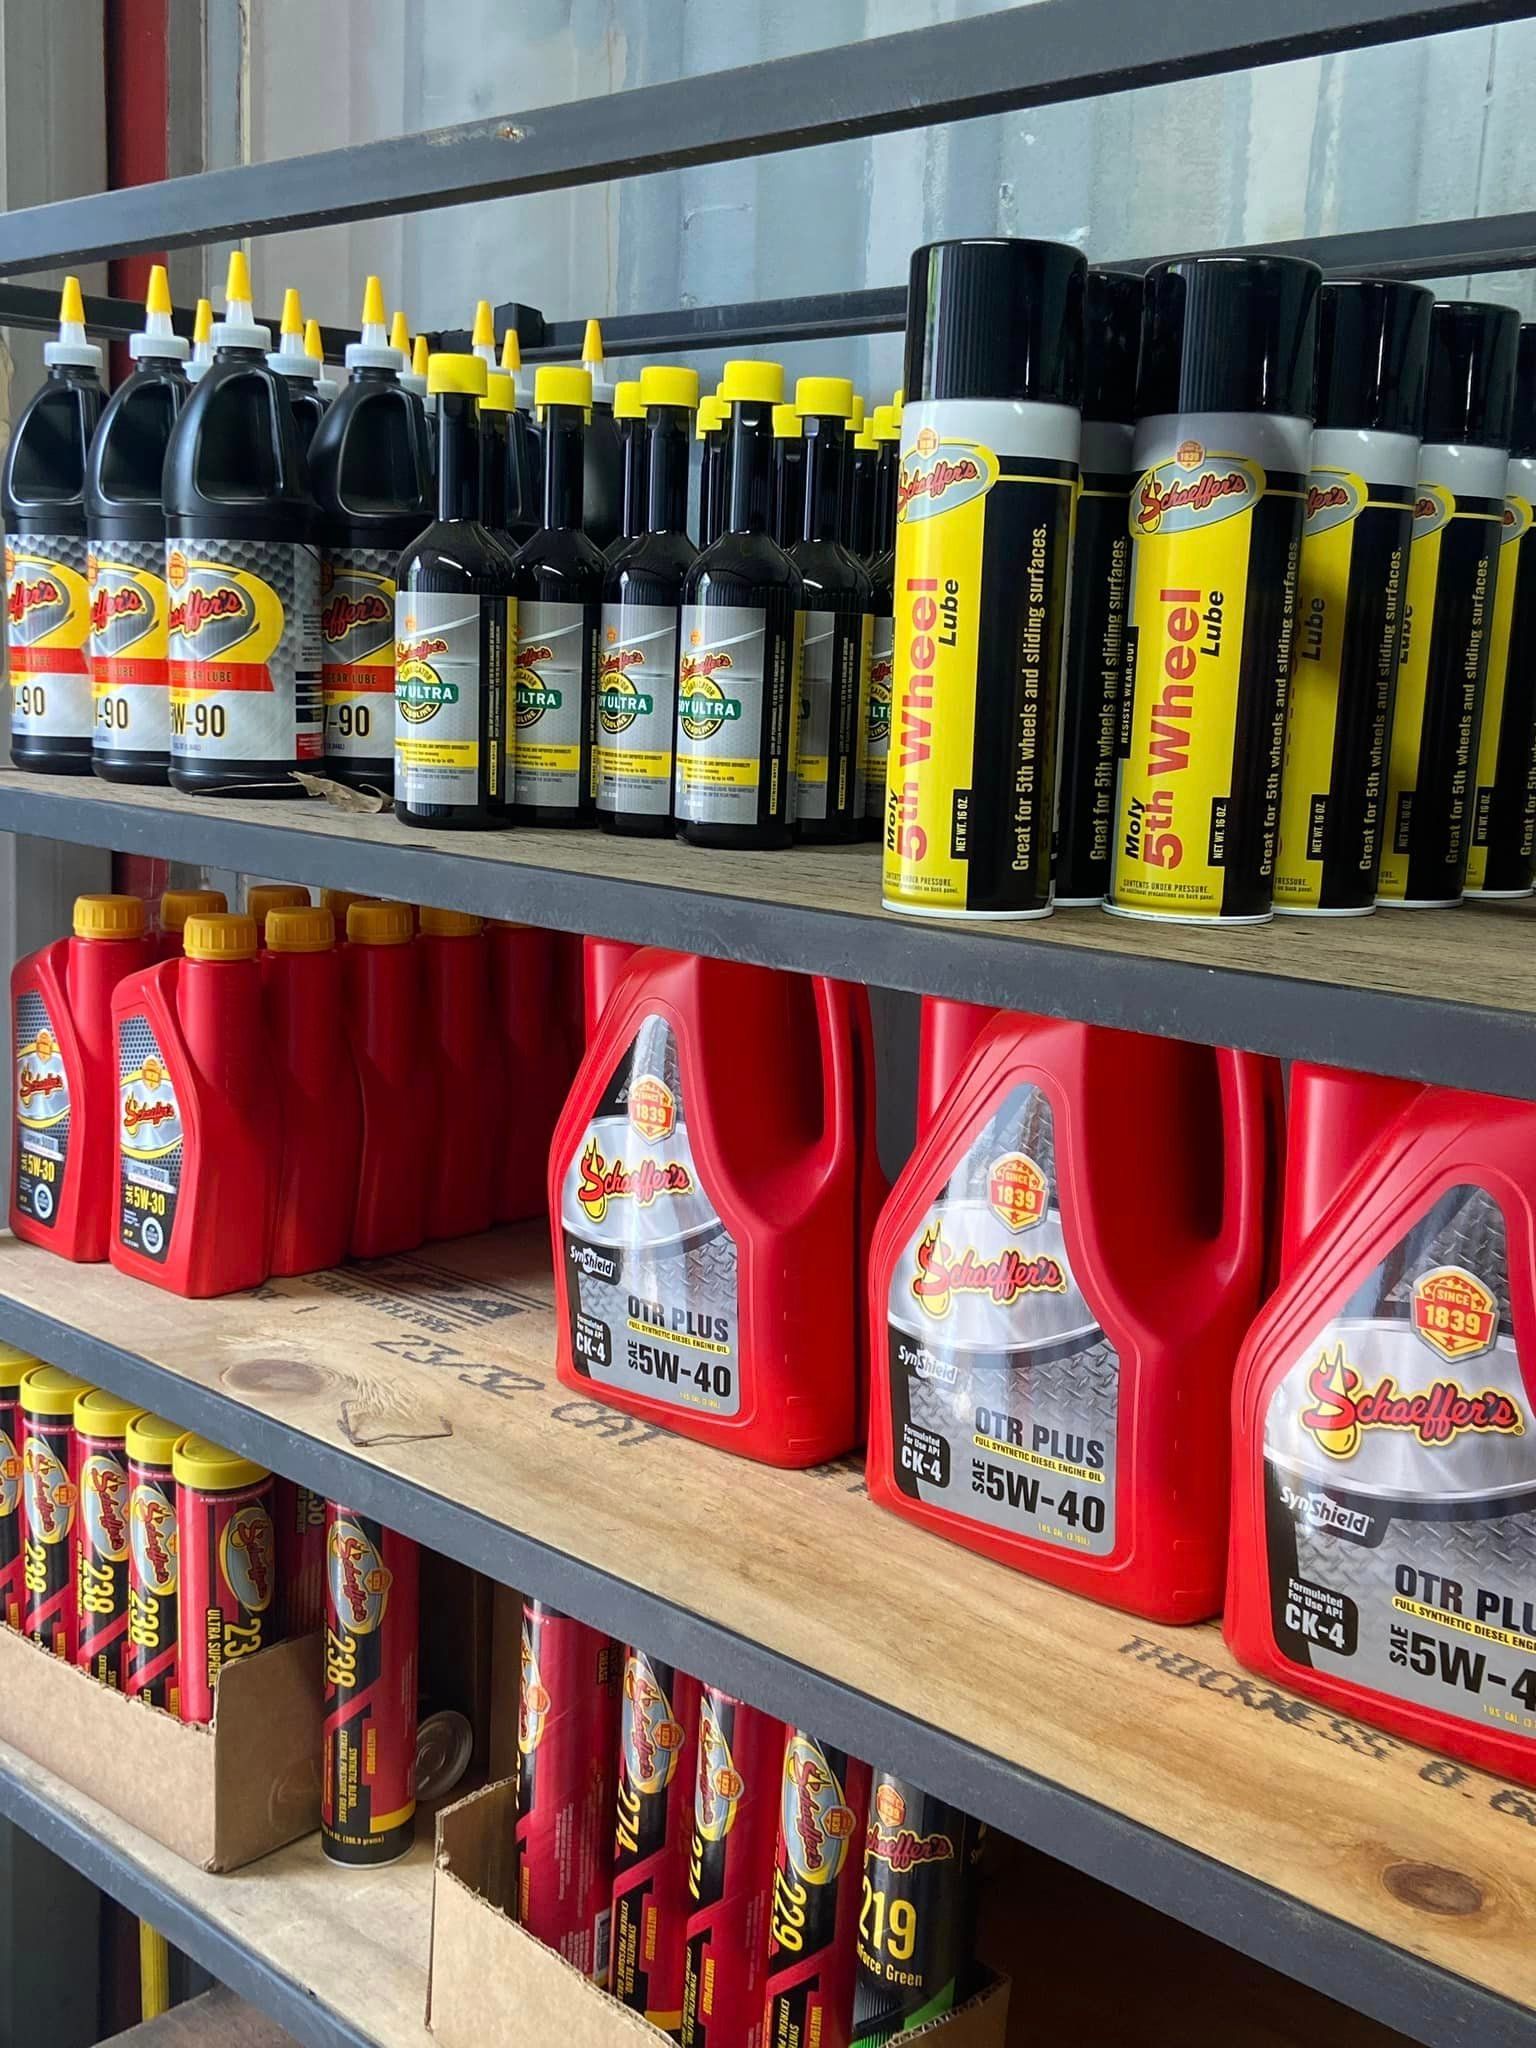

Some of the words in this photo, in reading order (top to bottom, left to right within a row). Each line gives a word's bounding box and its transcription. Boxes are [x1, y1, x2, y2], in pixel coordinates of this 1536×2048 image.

[1138, 474, 1247, 524] Schaeffer's
[1027, 523, 1047, 603] surfaces.
[1107, 536, 1126, 609] surfaces.
[1386, 547, 1402, 620] surfaces.
[1472, 554, 1489, 625] surfaces.
[938, 579, 959, 647] Lube
[1023, 599, 1045, 663] sliding
[1201, 591, 1224, 656] Lube
[1303, 598, 1326, 661] Lube
[1103, 612, 1122, 665] sliding
[1278, 616, 1293, 672] sliding
[1380, 621, 1394, 676] sliding
[1464, 627, 1482, 678] sliding
[207, 670, 232, 684] LUBE
[352, 674, 377, 686] LUBE
[899, 578, 938, 767] Wheel
[1022, 668, 1039, 698] and
[1102, 668, 1119, 699] and
[1124, 642, 1134, 697] WEAR-OUT
[1148, 589, 1201, 776] Wheel
[12, 685, 46, 716] -90
[95, 698, 129, 729] -90
[408, 685, 453, 701] ULTRA
[607, 695, 648, 711] ULTRA
[691, 702, 735, 717] ULTRA
[1276, 678, 1289, 707] and
[1374, 682, 1389, 710] and
[1461, 683, 1477, 710] and
[1020, 703, 1037, 760] wheels
[1097, 704, 1116, 758] wheels
[1120, 701, 1132, 743] RESISTS
[1271, 713, 1285, 768] wheels
[1370, 714, 1386, 767] wheels
[1456, 715, 1472, 765] wheels
[1016, 764, 1034, 792] 5th
[1095, 764, 1112, 788] 5th
[1266, 772, 1279, 799] 5th
[1366, 772, 1380, 797] 5th
[1452, 769, 1467, 794] 5th
[887, 791, 899, 851] Moly
[896, 782, 928, 862] 5th
[957, 811, 968, 820] 16
[1015, 799, 1032, 825] for
[1093, 792, 1109, 817] for
[1216, 818, 1226, 828] 16
[1264, 805, 1277, 828] for
[1313, 814, 1325, 824] 16
[1364, 801, 1377, 824] for
[1448, 798, 1464, 820] for
[955, 837, 966, 852] NET
[956, 822, 967, 835] WT.
[1012, 829, 1029, 870] Great
[1090, 821, 1107, 860] Great
[1125, 797, 1146, 860] Moly
[1143, 791, 1184, 870] 5th
[1214, 829, 1225, 842] WT.
[1311, 838, 1322, 853] NET
[1359, 829, 1375, 870] Great
[1445, 824, 1461, 863] Great
[1213, 844, 1224, 859] NET
[1259, 832, 1274, 876] Great
[636, 1103, 666, 1123] 1839
[28, 1154, 55, 1182] 5W-30
[578, 1151, 690, 1203] Schaeffer's
[125, 1184, 134, 1204] SAE
[134, 1186, 166, 1216] 5W-30
[997, 1186, 1036, 1210] 1839
[569, 1245, 614, 1276] SynShield
[913, 1240, 1062, 1301] Schaeffer's
[628, 1295, 664, 1327] OTR
[672, 1307, 729, 1342] PLUS
[1436, 1289, 1470, 1306] SINCE
[628, 1321, 640, 1331] FULL
[641, 1325, 671, 1340] SYNTHETIC
[672, 1333, 692, 1346] DIESEL
[693, 1339, 715, 1352] ENGINE
[716, 1345, 728, 1354] OIL
[1425, 1306, 1481, 1335] 1839
[576, 1335, 606, 1362] CK-4
[628, 1339, 639, 1370] SAE
[639, 1344, 732, 1398] 5W-40
[898, 1345, 957, 1384] SynShield
[1303, 1364, 1517, 1442] Schaeffer's
[903, 1424, 940, 1447] Formulated
[903, 1434, 913, 1446] For
[928, 1443, 940, 1457] API
[975, 1406, 1023, 1447] OTR
[1032, 1423, 1105, 1469] PLUS
[901, 1445, 942, 1482] CK-4
[975, 1436, 991, 1449] FULL
[992, 1442, 1030, 1463] SYNTHETIC
[1031, 1454, 1057, 1471] DIESEL
[1058, 1463, 1087, 1480] ENGINE
[1088, 1471, 1103, 1483] OIL
[27, 1449, 57, 1533] Schaeffer's
[90, 1466, 128, 1552] Schaeffer's
[972, 1458, 986, 1494] SAE
[986, 1464, 1105, 1535] 5W-40
[1280, 1486, 1367, 1536] SynShield
[141, 1500, 172, 1585] Schaeffer's
[237, 1520, 273, 1600] Schaeffer's
[24, 1539, 47, 1594] 238
[81, 1559, 114, 1615] 238
[335, 1534, 369, 1623] Schaeffer's
[1288, 1590, 1303, 1604] For
[1304, 1595, 1323, 1612] Use
[1325, 1603, 1343, 1620] API
[1289, 1577, 1343, 1608] Formulated
[1395, 1563, 1464, 1615] OTR
[1476, 1588, 1536, 1637] PLU
[131, 1589, 160, 1648] 238
[207, 1609, 221, 1639] ULTRA
[224, 1617, 262, 1664] 23
[1285, 1603, 1345, 1649] CK-4
[1394, 1598, 1416, 1614] FULL
[1419, 1606, 1472, 1632] SYNTHETIC
[1474, 1623, 1509, 1644] DIESEL
[327, 1632, 356, 1689] 238
[1389, 1624, 1408, 1667] SAE
[1409, 1631, 1536, 1712] 5W-4
[366, 1728, 377, 1775] WATERPROOF
[615, 1780, 641, 1853] 274
[793, 1752, 826, 1868] Schaeffer's
[619, 1900, 629, 1936] EXTREME
[772, 1868, 807, 1952] 229
[859, 1876, 917, 1960] 219
[627, 1923, 637, 1967] SYNTHETIC
[645, 1907, 657, 1960] WATERPROOF
[617, 1937, 627, 1977] PRESSURE
[886, 1965, 922, 1988] Green
[688, 1971, 698, 2017] SYNTHETIC
[703, 1958, 715, 2016] WATERPROOF
[778, 1998, 790, 2036] EXTREME
